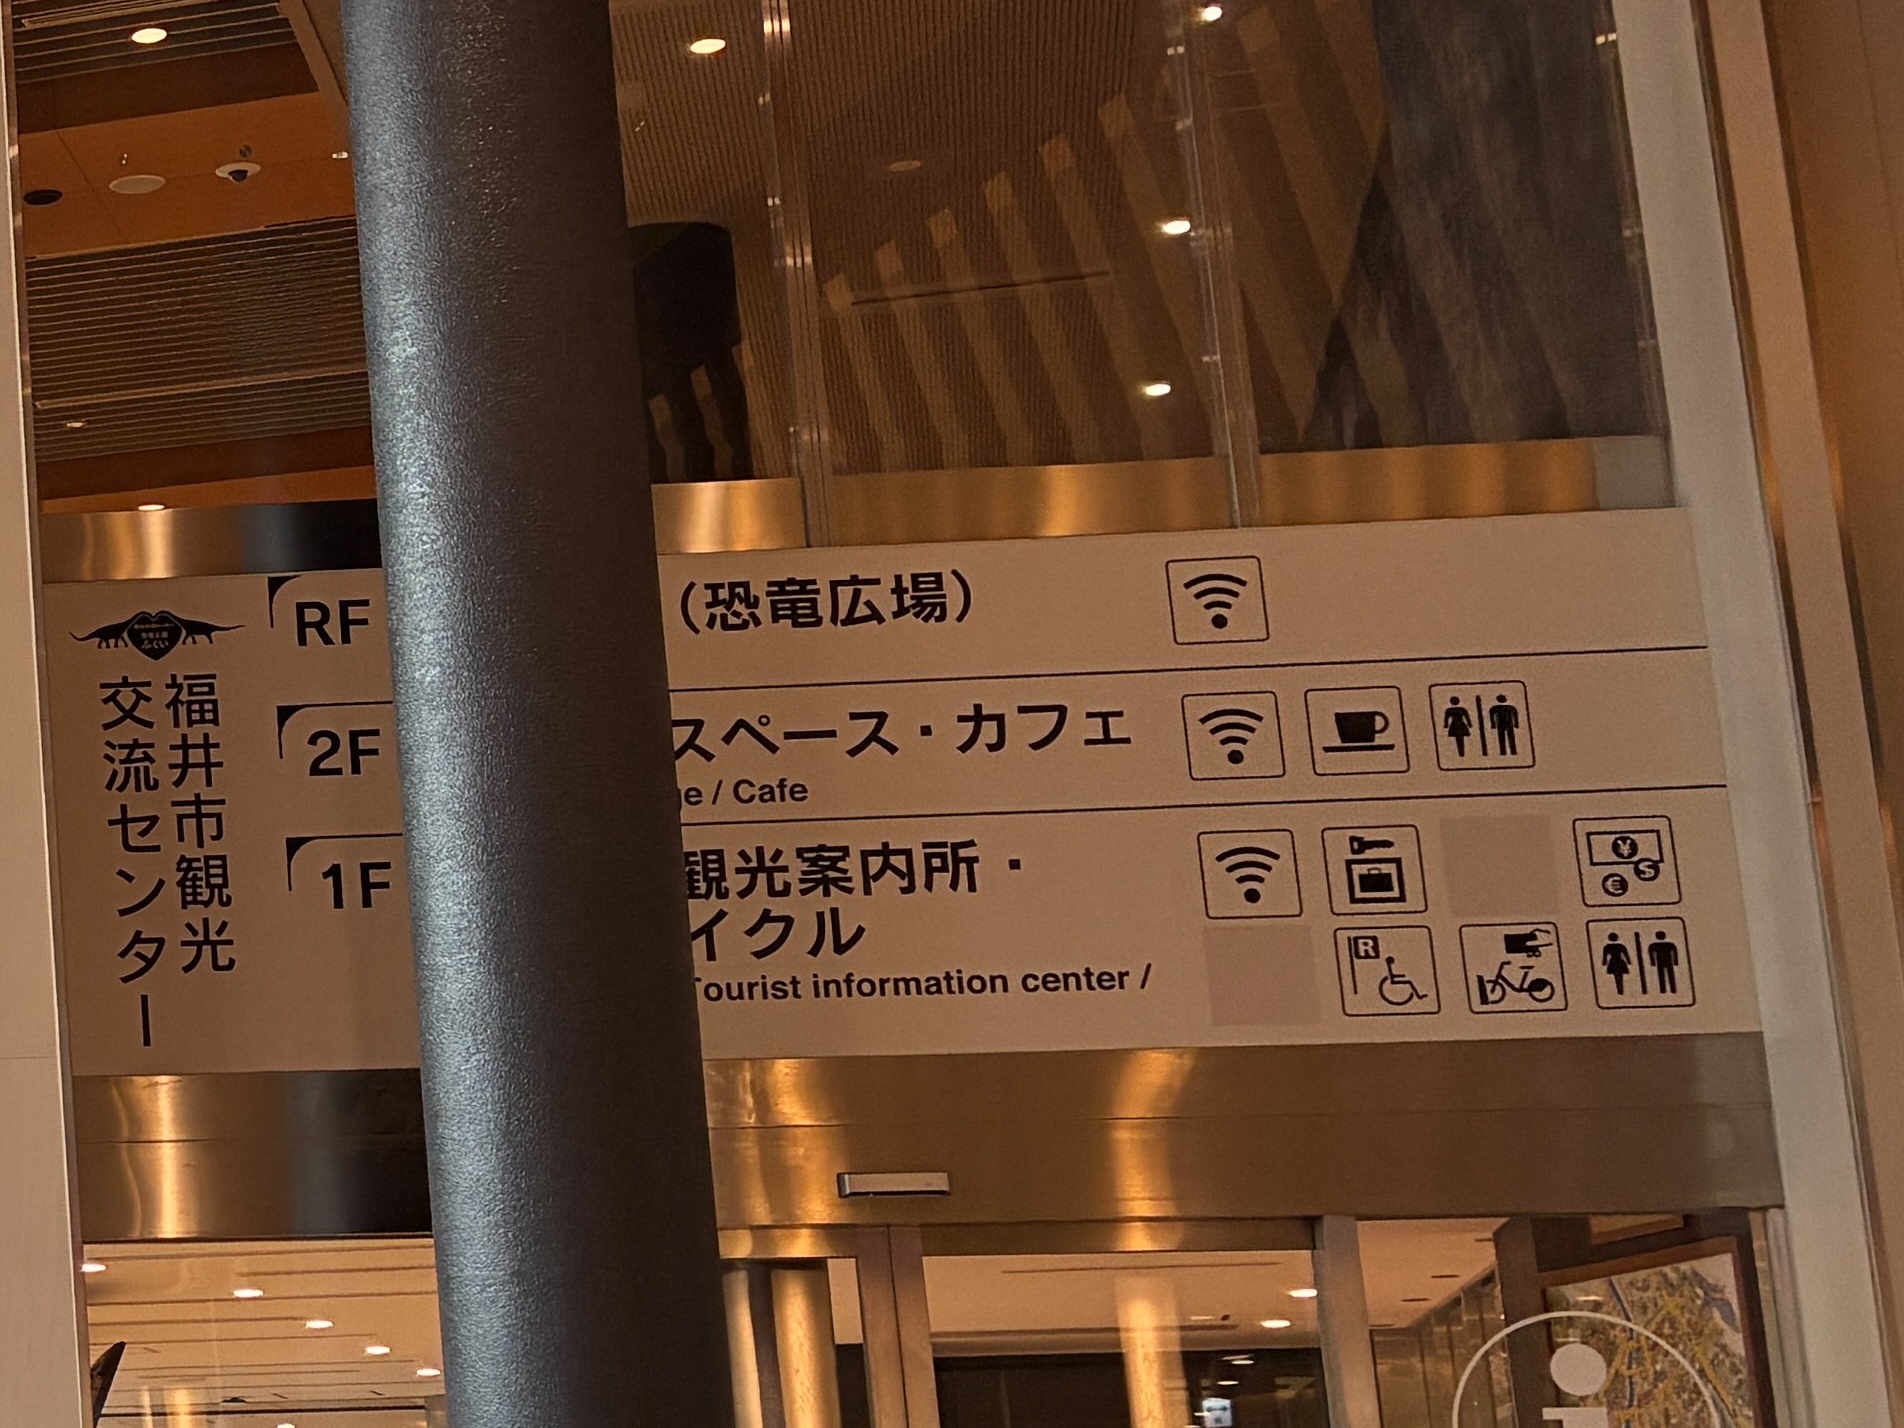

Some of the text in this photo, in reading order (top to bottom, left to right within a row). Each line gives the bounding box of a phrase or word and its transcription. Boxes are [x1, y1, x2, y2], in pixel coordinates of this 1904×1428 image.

[295, 598, 371, 647] RF
[679, 568, 972, 635] （恐竜広場）
[306, 728, 382, 778] 2F
[671, 702, 1132, 762] スペース・カフェ
[732, 778, 809, 805] Cafe
[164, 672, 237, 974] 福井市観光
[98, 674, 167, 1048] 交流センター
[321, 860, 393, 910] 1F
[690, 906, 866, 962] イクル
[812, 968, 1009, 1000] information
[1020, 966, 1130, 994] center
